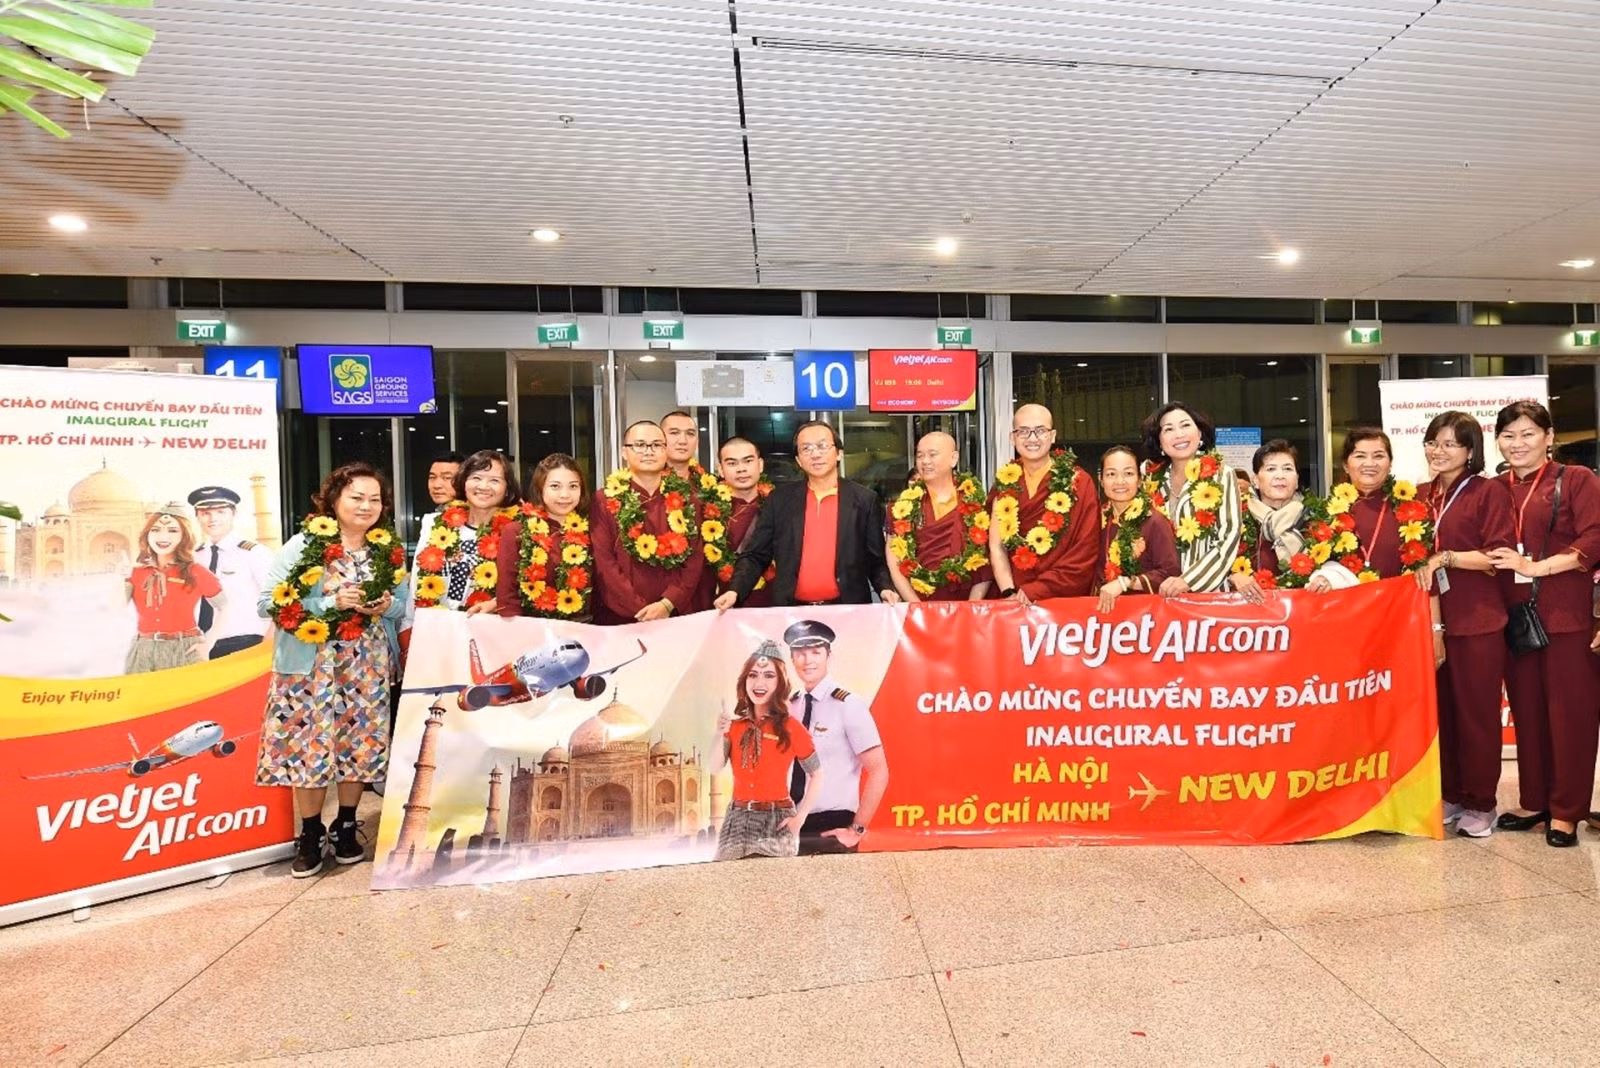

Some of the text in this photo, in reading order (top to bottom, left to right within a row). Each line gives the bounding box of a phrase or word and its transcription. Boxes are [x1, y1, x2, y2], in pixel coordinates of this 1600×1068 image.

[188, 324, 217, 338] EXIT
[546, 327, 569, 341] EXIT
[652, 325, 675, 337] EXIT
[944, 331, 964, 342] EXIT
[801, 362, 849, 398] 10
[334, 391, 372, 403] SAGS
[1480, 398, 1497, 407] BAY
[0, 396, 46, 409] CHÀO
[51, 397, 99, 411] MỪNG
[103, 399, 164, 413] CHUYẾN
[168, 403, 197, 413] BAY
[232, 404, 263, 415] TIÊN
[1476, 409, 1500, 417] FLIGH
[66, 415, 209, 428] INAUGURAL FLIGHT
[0, 434, 22, 445] TP.
[57, 433, 86, 445] CHÍ
[90, 435, 134, 446] MINH
[162, 437, 208, 449] NEW
[213, 438, 267, 449] DELHI
[22, 688, 122, 706] Enjoy Flying!
[916, 669, 1392, 714] CHÀO MỪNG CHUYẾN BAY ĐẦU TIÊN
[1026, 722, 1296, 748] INAUGURAL FLIGHT
[1013, 756, 1109, 789] HÀ NỘI
[1178, 751, 1389, 804] NEW DELHI
[891, 794, 1111, 827] TP. HỒ CHÍ MINH
